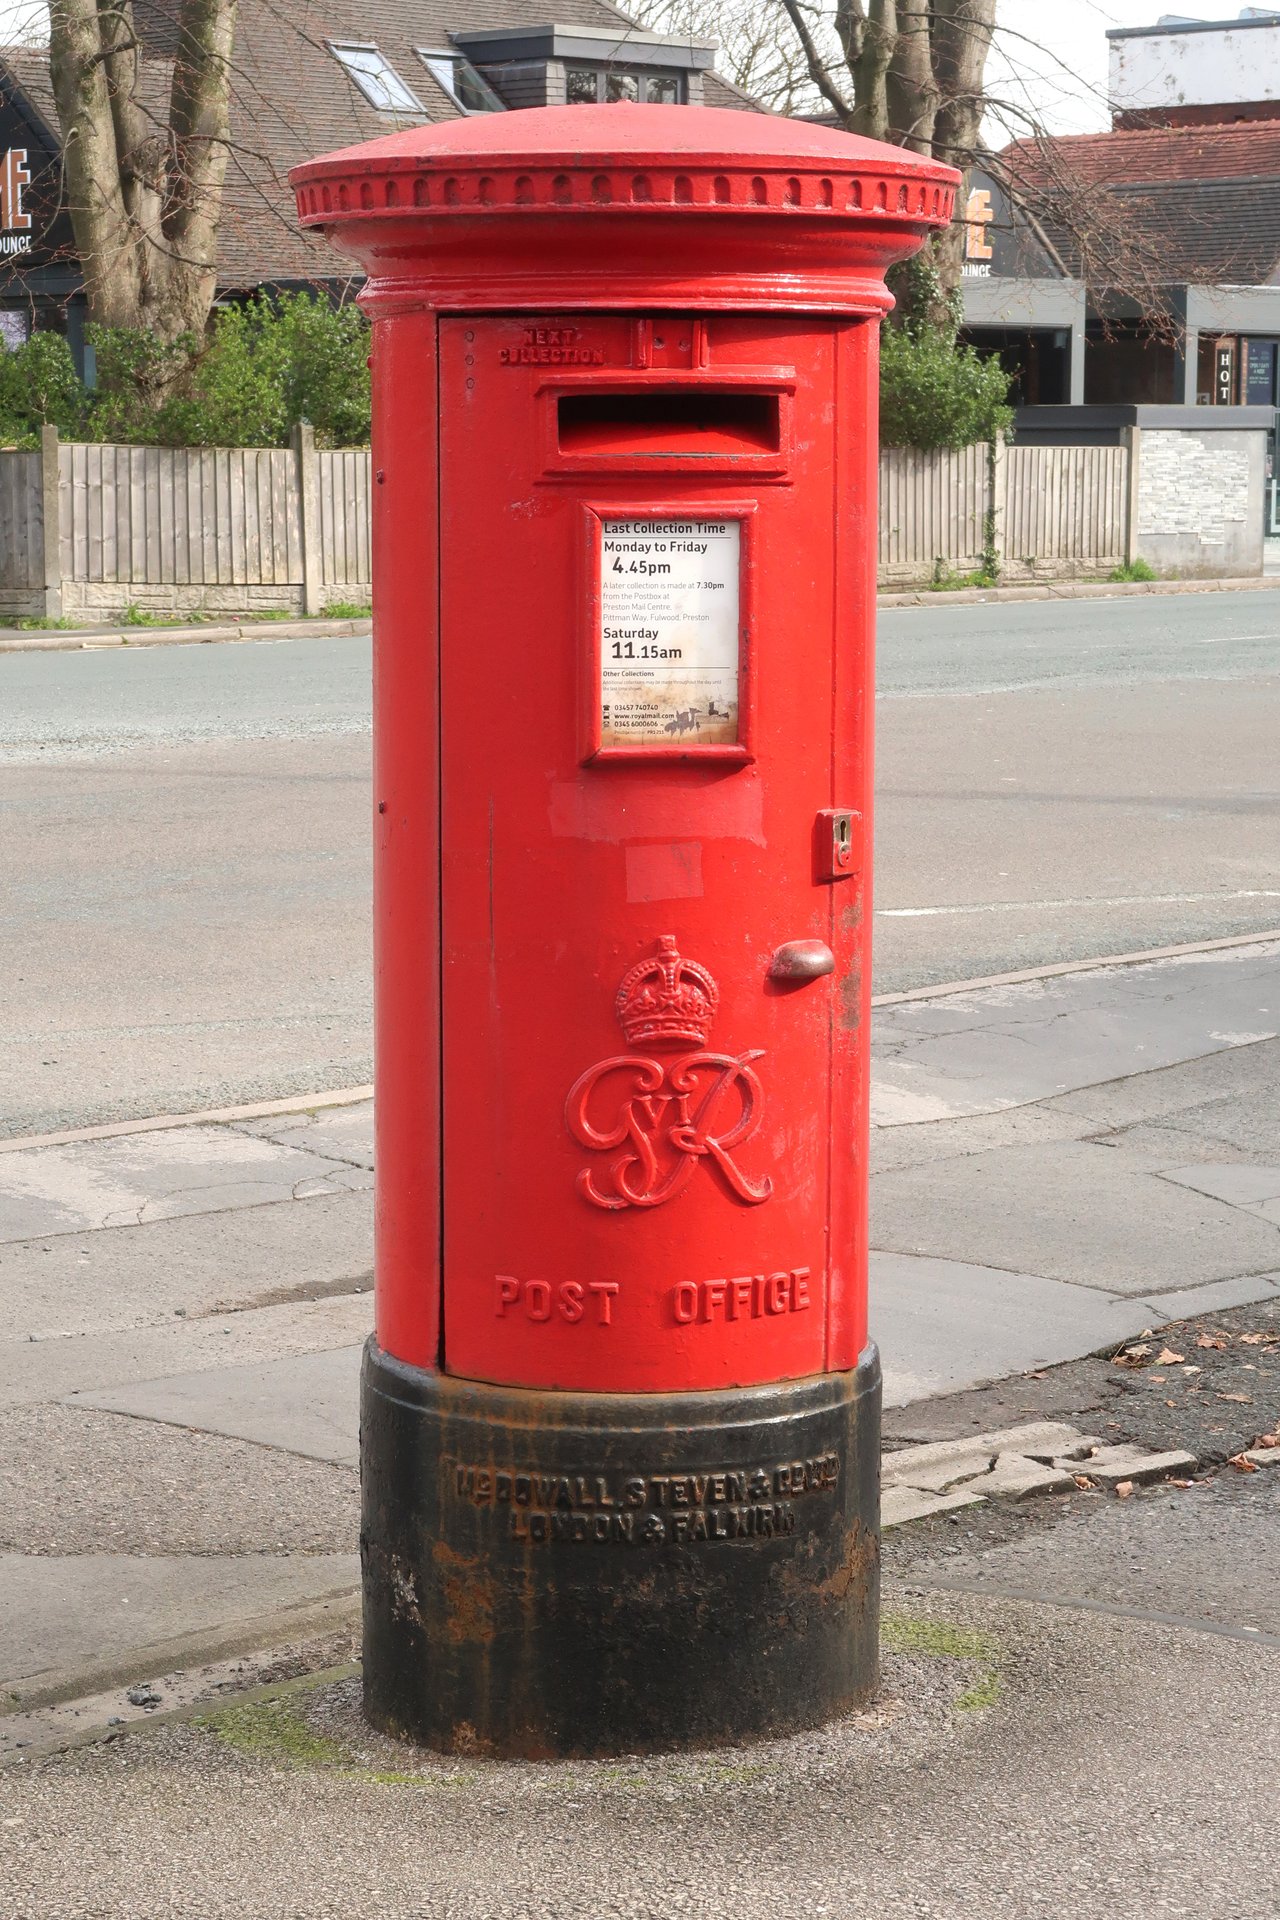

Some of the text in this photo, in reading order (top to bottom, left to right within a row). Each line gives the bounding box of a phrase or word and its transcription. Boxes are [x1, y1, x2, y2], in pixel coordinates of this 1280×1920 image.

[523, 328, 576, 346] NEXT
[499, 349, 605, 366] COLLECTION
[604, 522, 726, 534] Last Collection Time
[604, 541, 708, 554] Monday to Friday
[612, 557, 671, 576] 4.45pm
[696, 582, 725, 591] 7.30pm
[603, 628, 659, 640] Saturday
[611, 641, 682, 659] 11.15am
[495, 1266, 811, 1326] POST OFFICE
[625, 1471, 747, 1506] STEVEN
[511, 1511, 633, 1543] LONDON
[643, 1513, 666, 1543] &
